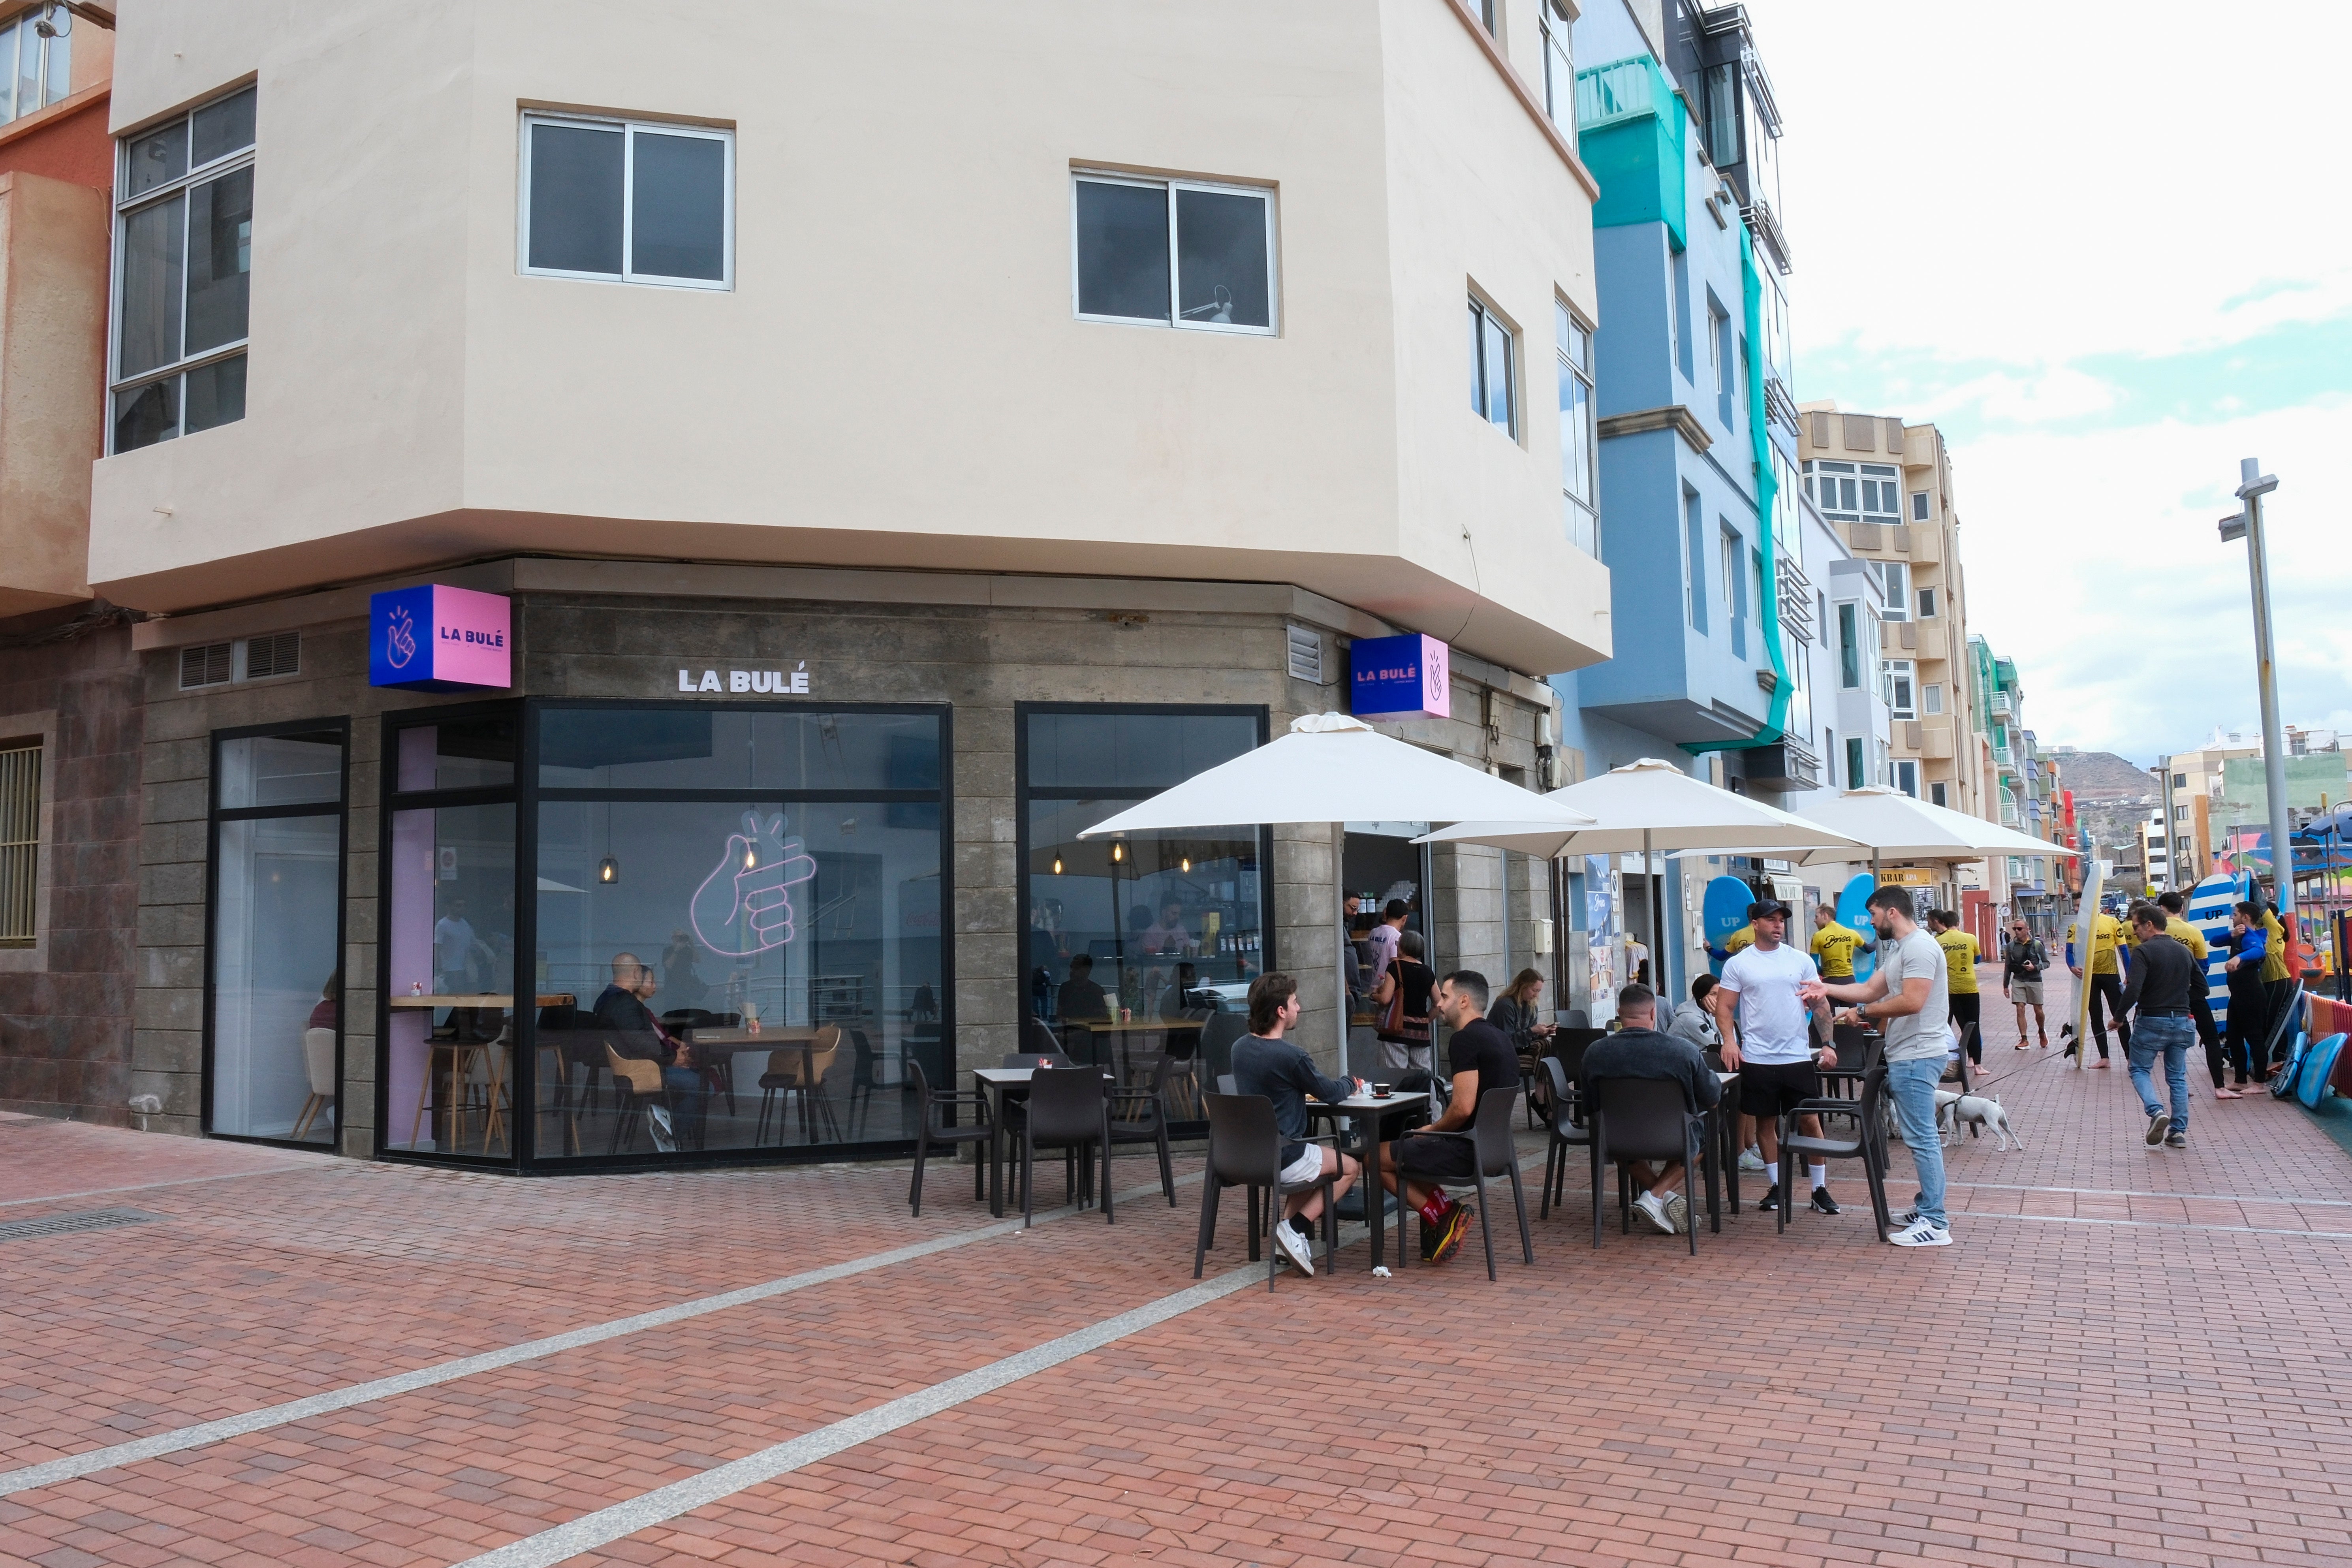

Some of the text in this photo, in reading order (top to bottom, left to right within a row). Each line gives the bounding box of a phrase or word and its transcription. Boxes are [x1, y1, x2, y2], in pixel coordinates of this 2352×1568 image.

[441, 626, 503, 647] LA BULÉ
[679, 660, 809, 694] LA BULÉ
[1357, 663, 1416, 681] LA BULÉ
[1721, 917, 1740, 927] UP
[1854, 915, 1868, 925] UP
[2205, 910, 2223, 920] UP
[1824, 934, 1852, 949] Brisa
